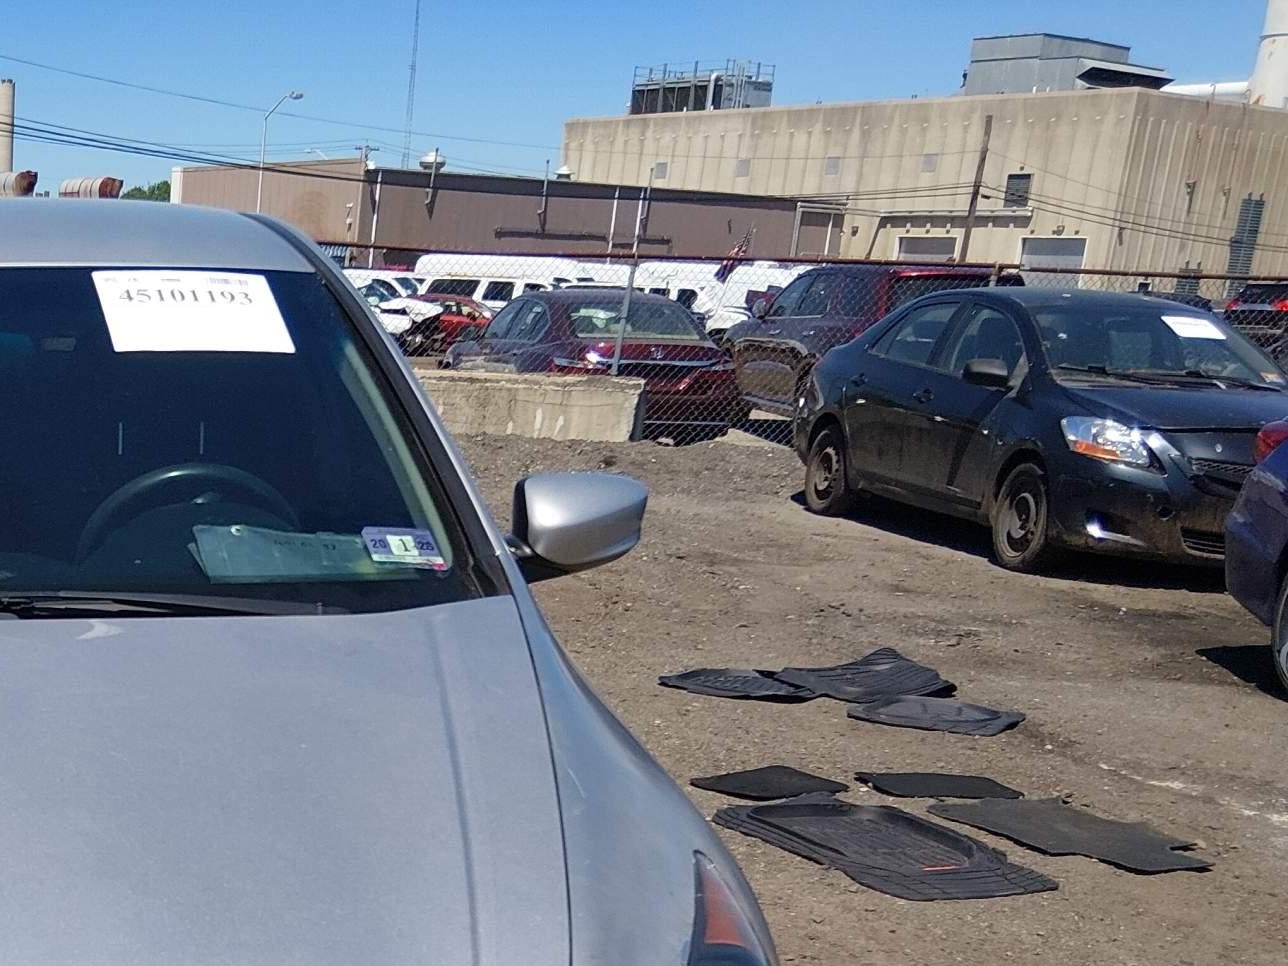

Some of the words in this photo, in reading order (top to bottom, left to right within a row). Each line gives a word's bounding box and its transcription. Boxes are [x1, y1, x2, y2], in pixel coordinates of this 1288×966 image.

[118, 288, 254, 306] 45101193
[370, 538, 387, 549] 20
[399, 538, 411, 553] 1
